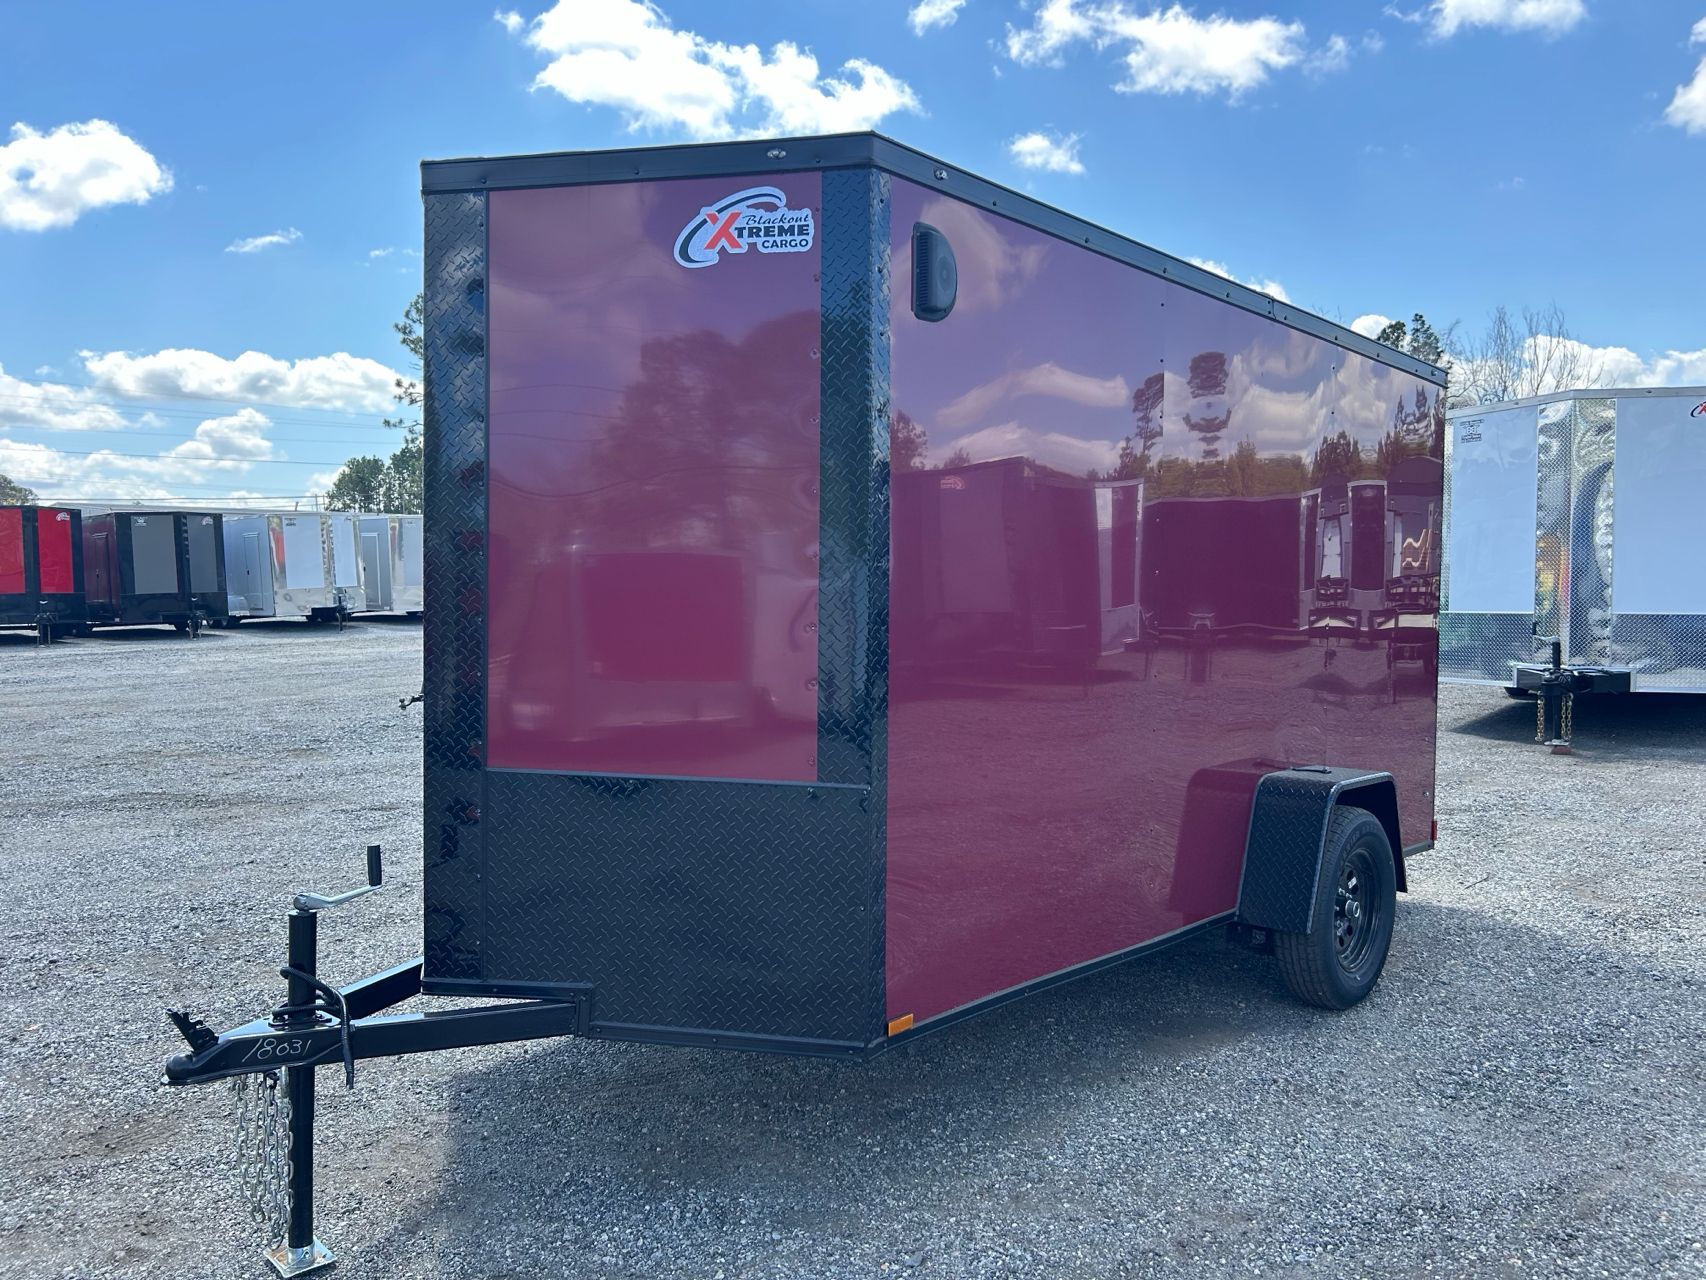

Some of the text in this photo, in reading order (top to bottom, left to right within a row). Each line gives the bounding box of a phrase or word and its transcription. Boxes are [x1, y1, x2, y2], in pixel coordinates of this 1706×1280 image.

[742, 213, 809, 225] Blackout
[704, 212, 810, 249] XTREME
[762, 238, 809, 249] CARGO
[241, 1038, 312, 1062] 18031
